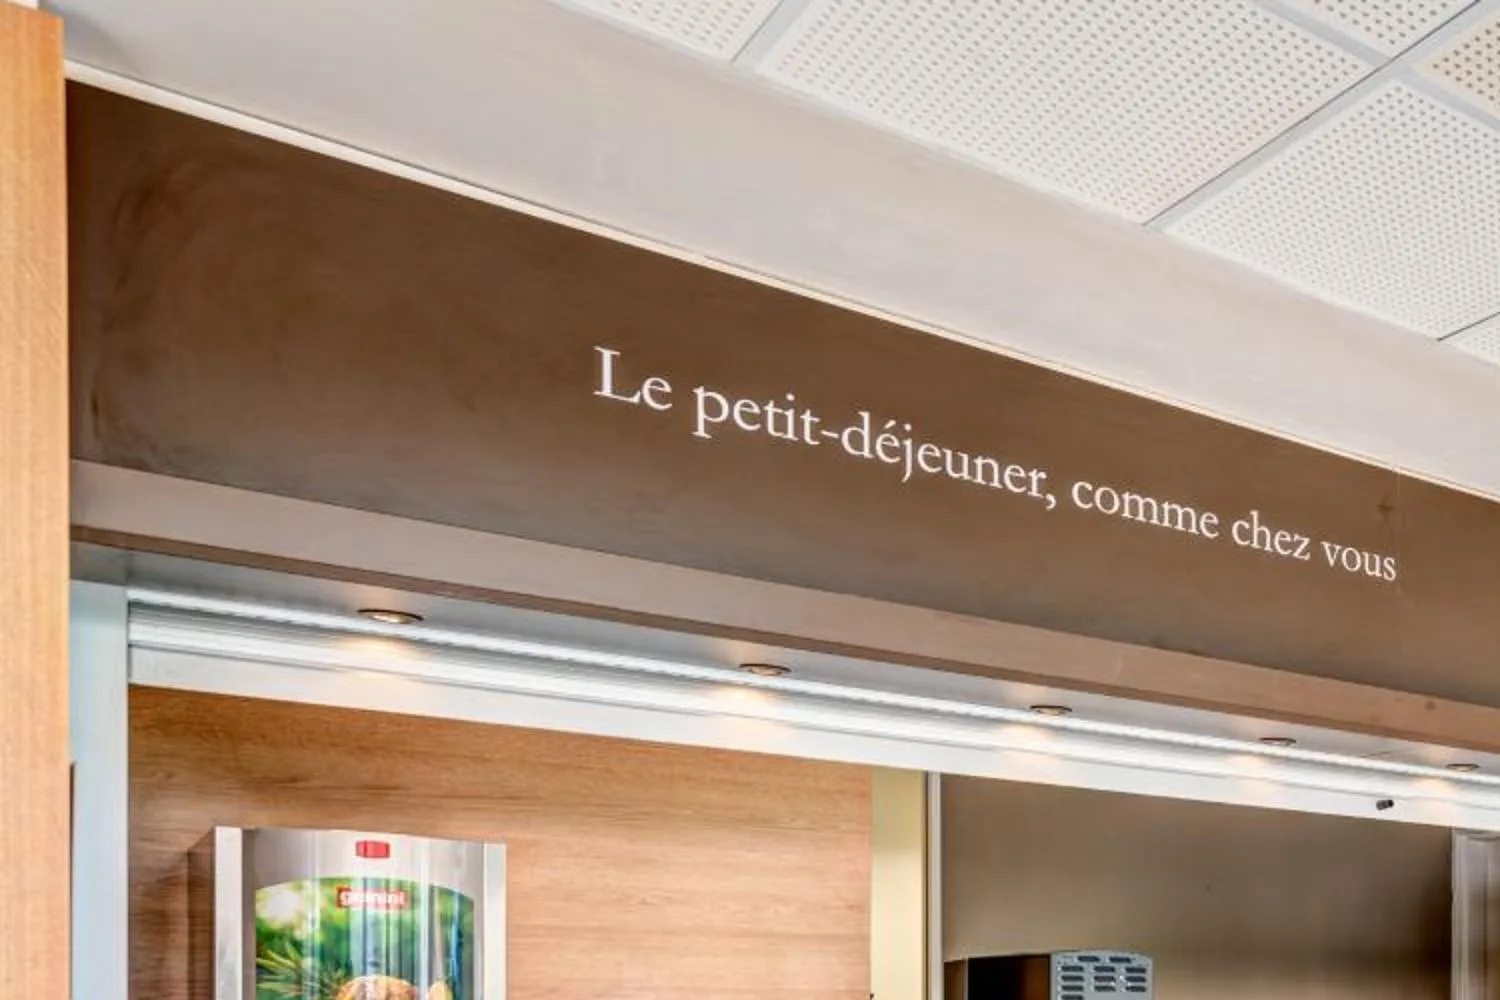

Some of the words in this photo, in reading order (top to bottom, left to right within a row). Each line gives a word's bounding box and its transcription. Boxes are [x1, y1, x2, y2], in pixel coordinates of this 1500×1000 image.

[594, 346, 673, 411] Le
[693, 385, 1058, 511] petit-déjeuner,
[1071, 480, 1219, 540] comme
[1231, 509, 1310, 562] chez
[1321, 541, 1397, 582] vous
